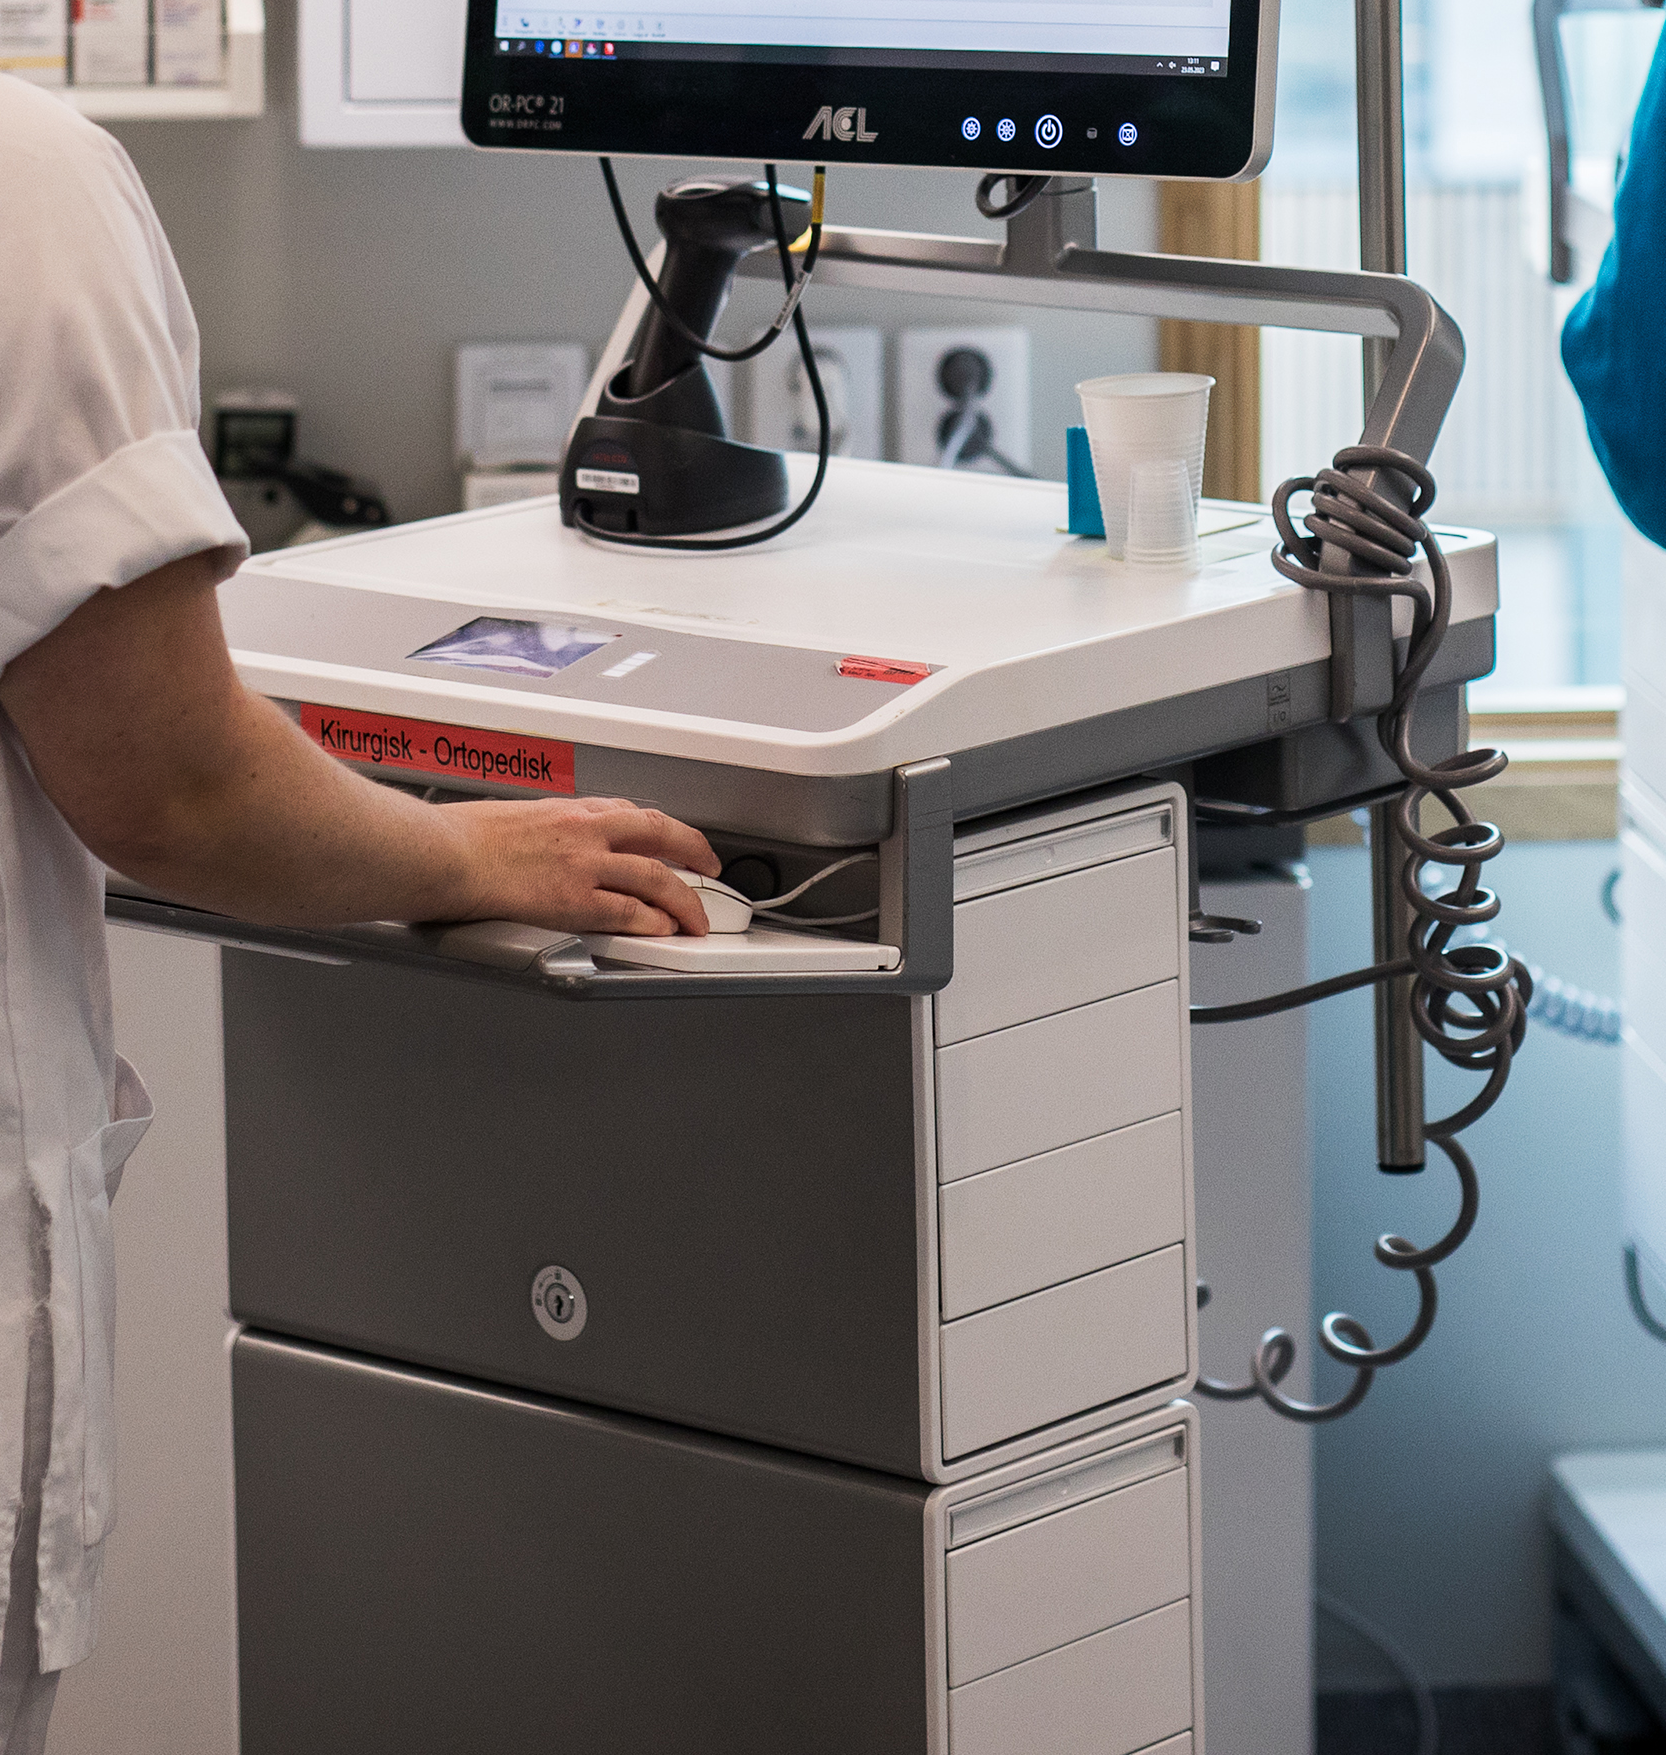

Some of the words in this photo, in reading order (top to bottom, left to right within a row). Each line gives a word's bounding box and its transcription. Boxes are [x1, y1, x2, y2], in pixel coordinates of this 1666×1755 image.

[549, 96, 564, 115] 21
[802, 106, 879, 142] ACL
[320, 719, 413, 762] Kirurgisk
[434, 736, 553, 782] Ortopedisk
